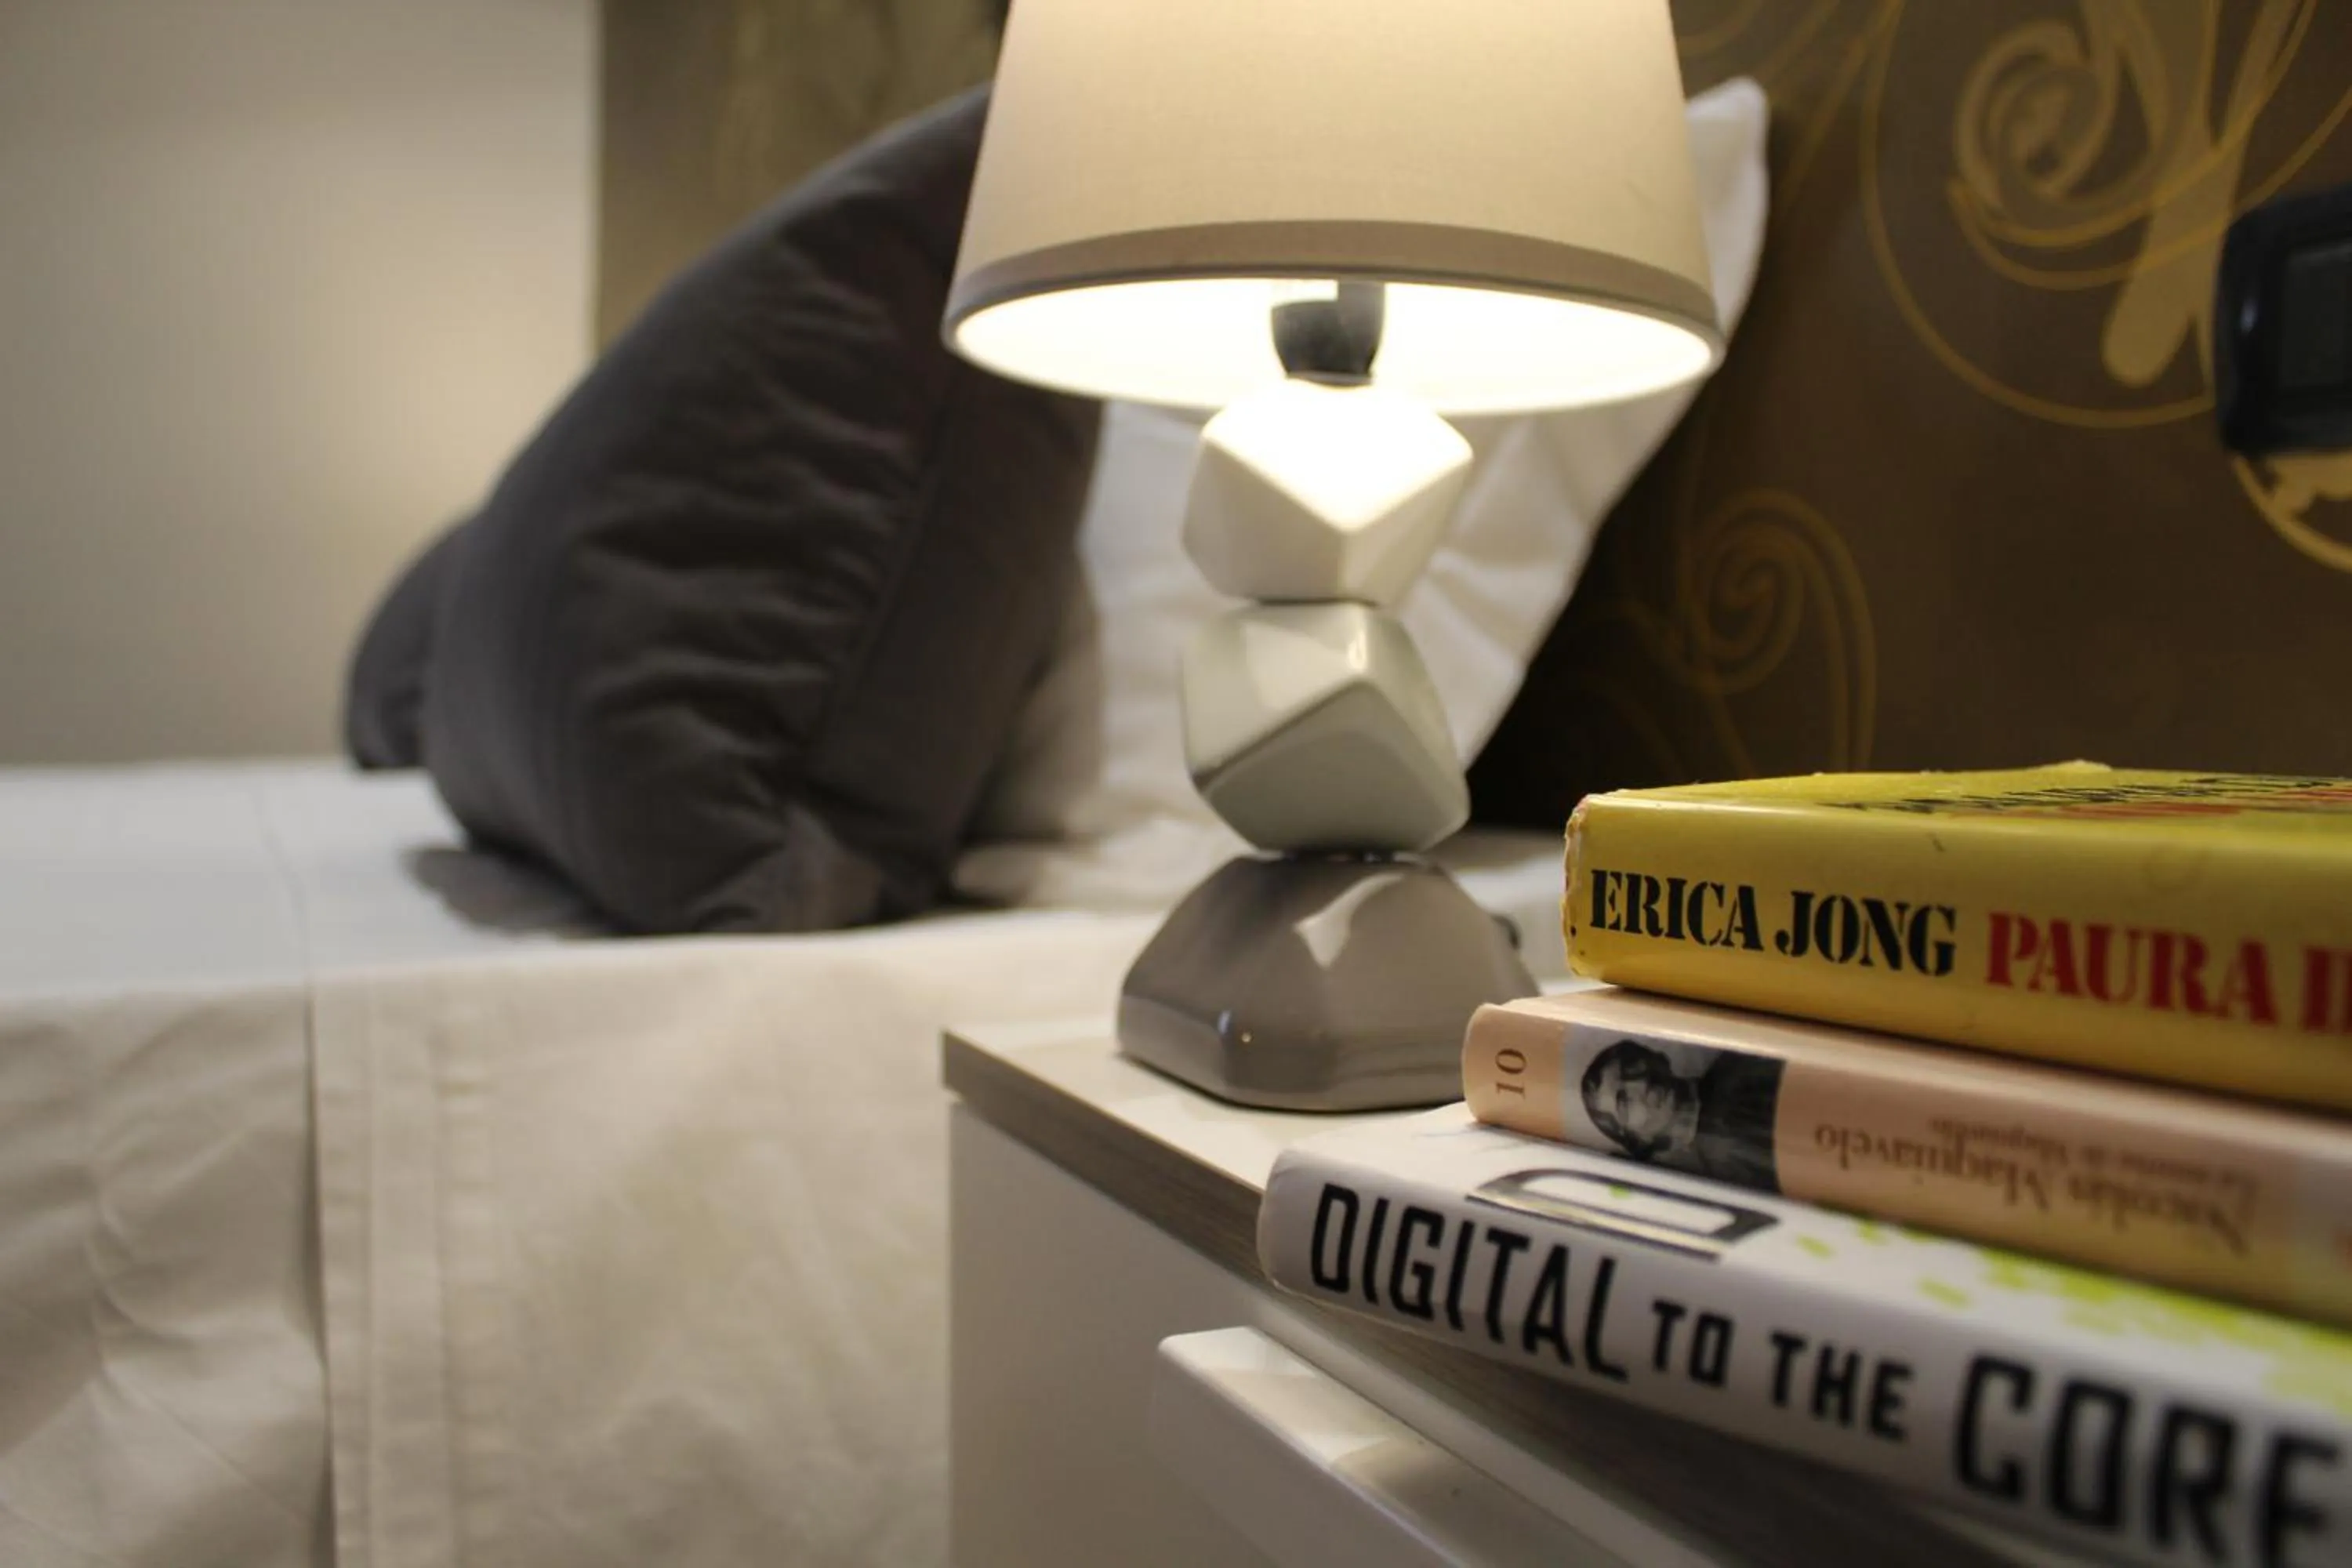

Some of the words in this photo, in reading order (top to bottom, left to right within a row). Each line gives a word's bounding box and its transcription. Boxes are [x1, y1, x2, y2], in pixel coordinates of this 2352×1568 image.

[1588, 869, 1763, 952] ERICA
[1774, 891, 1957, 977] JONG
[1984, 911, 2280, 1026] PAURA
[1494, 1047, 1527, 1099] 10
[1813, 1122, 2052, 1212] Maquiavelo
[1310, 1181, 1630, 1385] DIGITAL
[1651, 1298, 1734, 1388] TO
[1769, 1330, 1915, 1443] THE
[1951, 1352, 2343, 1568] CORE
